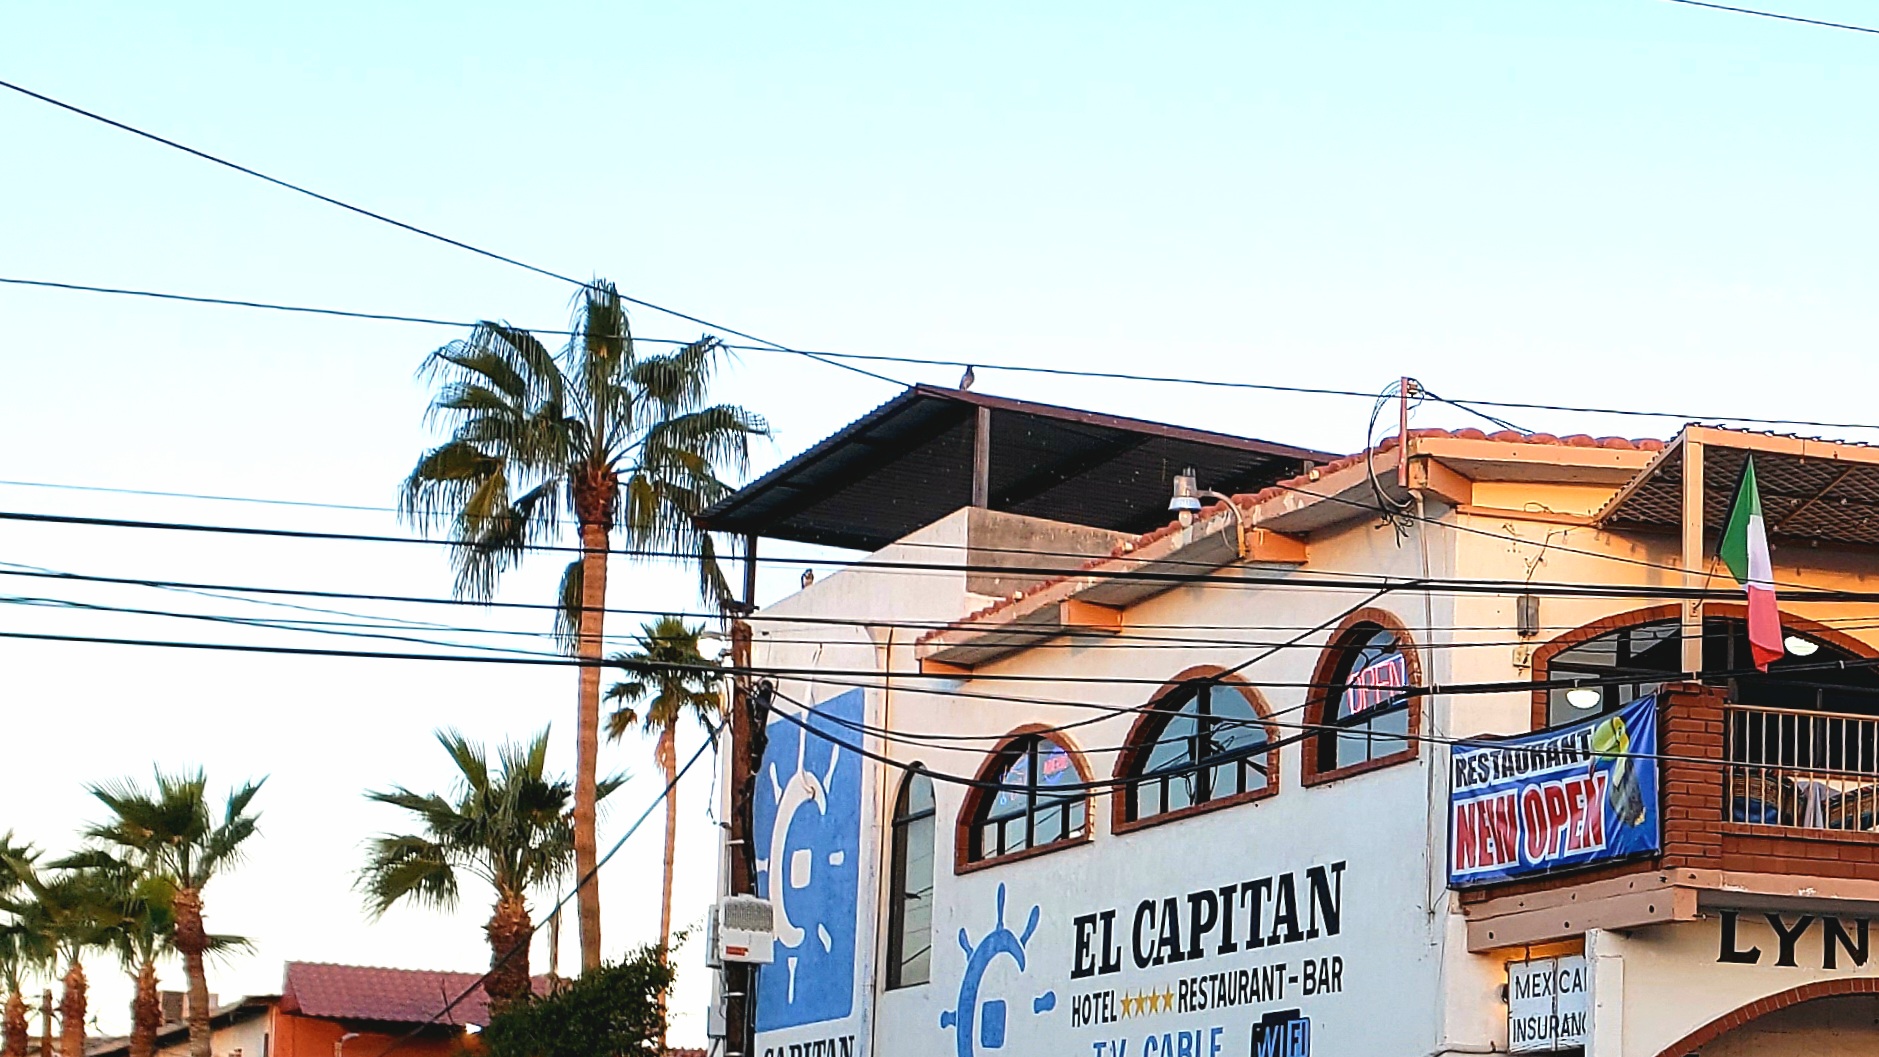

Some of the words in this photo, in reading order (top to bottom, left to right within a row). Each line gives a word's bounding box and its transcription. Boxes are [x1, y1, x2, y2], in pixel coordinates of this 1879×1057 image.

[1455, 728, 1593, 788] RESTAURANT
[1456, 794, 1518, 870] NEW
[1523, 775, 1606, 858] OPEN
[1070, 909, 1122, 979] EL
[1132, 860, 1346, 969] CAPITAN
[1071, 990, 1118, 1028] HOTEL
